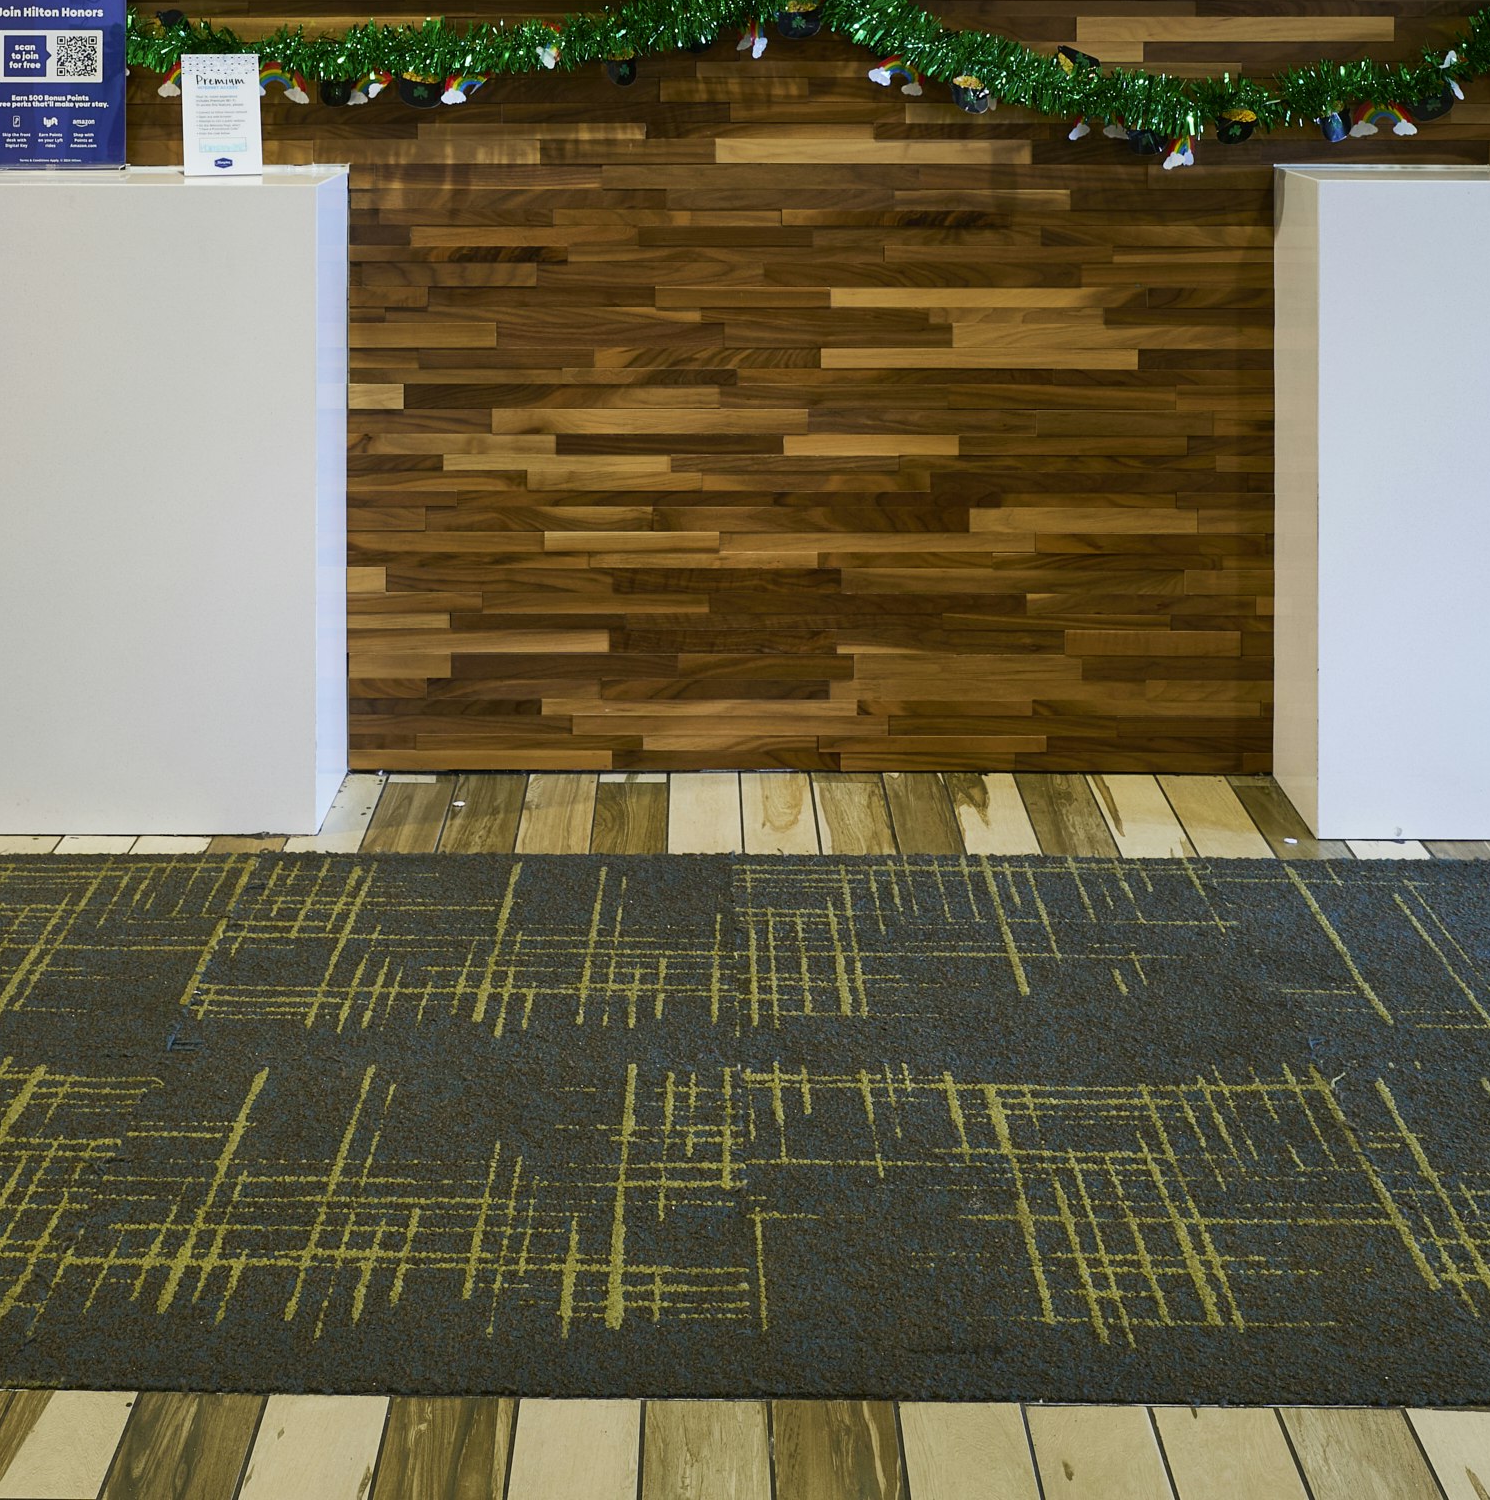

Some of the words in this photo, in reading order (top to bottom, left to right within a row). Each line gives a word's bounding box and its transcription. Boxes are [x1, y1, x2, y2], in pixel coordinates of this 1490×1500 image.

[23, 5, 60, 18] Hilton
[61, 6, 104, 18] Honors
[11, 52, 21, 60] to
[21, 52, 39, 61] join
[9, 61, 22, 69] for
[23, 61, 41, 69] free
[195, 74, 245, 86] Premium
[43, 117, 58, 128] lyft
